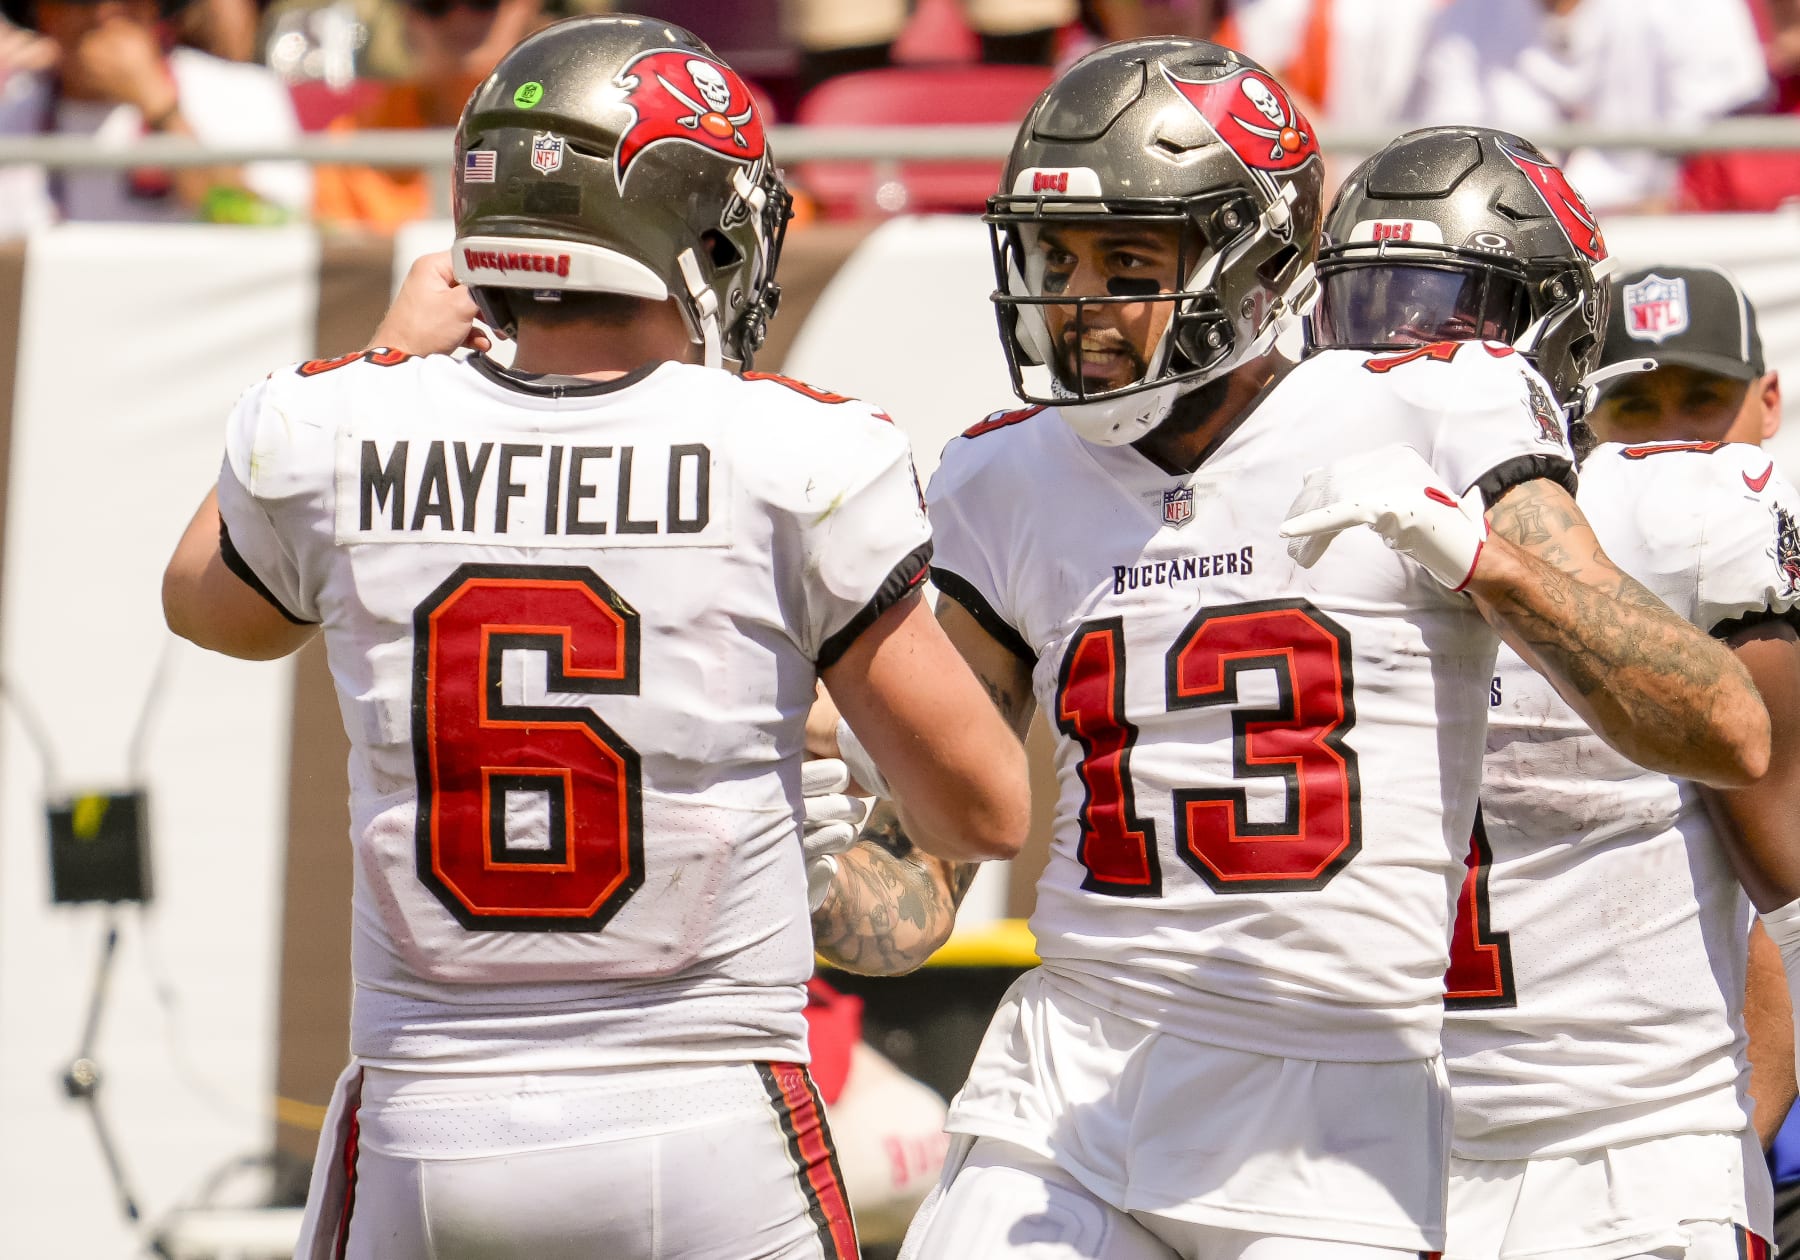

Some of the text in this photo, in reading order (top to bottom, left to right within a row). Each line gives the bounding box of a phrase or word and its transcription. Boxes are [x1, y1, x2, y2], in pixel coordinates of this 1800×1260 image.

[535, 150, 558, 167] NFL
[463, 247, 571, 278] BUCCANEERS
[1631, 300, 1678, 331] NFL
[360, 440, 711, 535] MAYFIELD
[1165, 501, 1190, 519] NFL
[1112, 546, 1253, 595] BUCCANEERS
[411, 562, 645, 932] 6
[1055, 597, 1363, 898] 13
